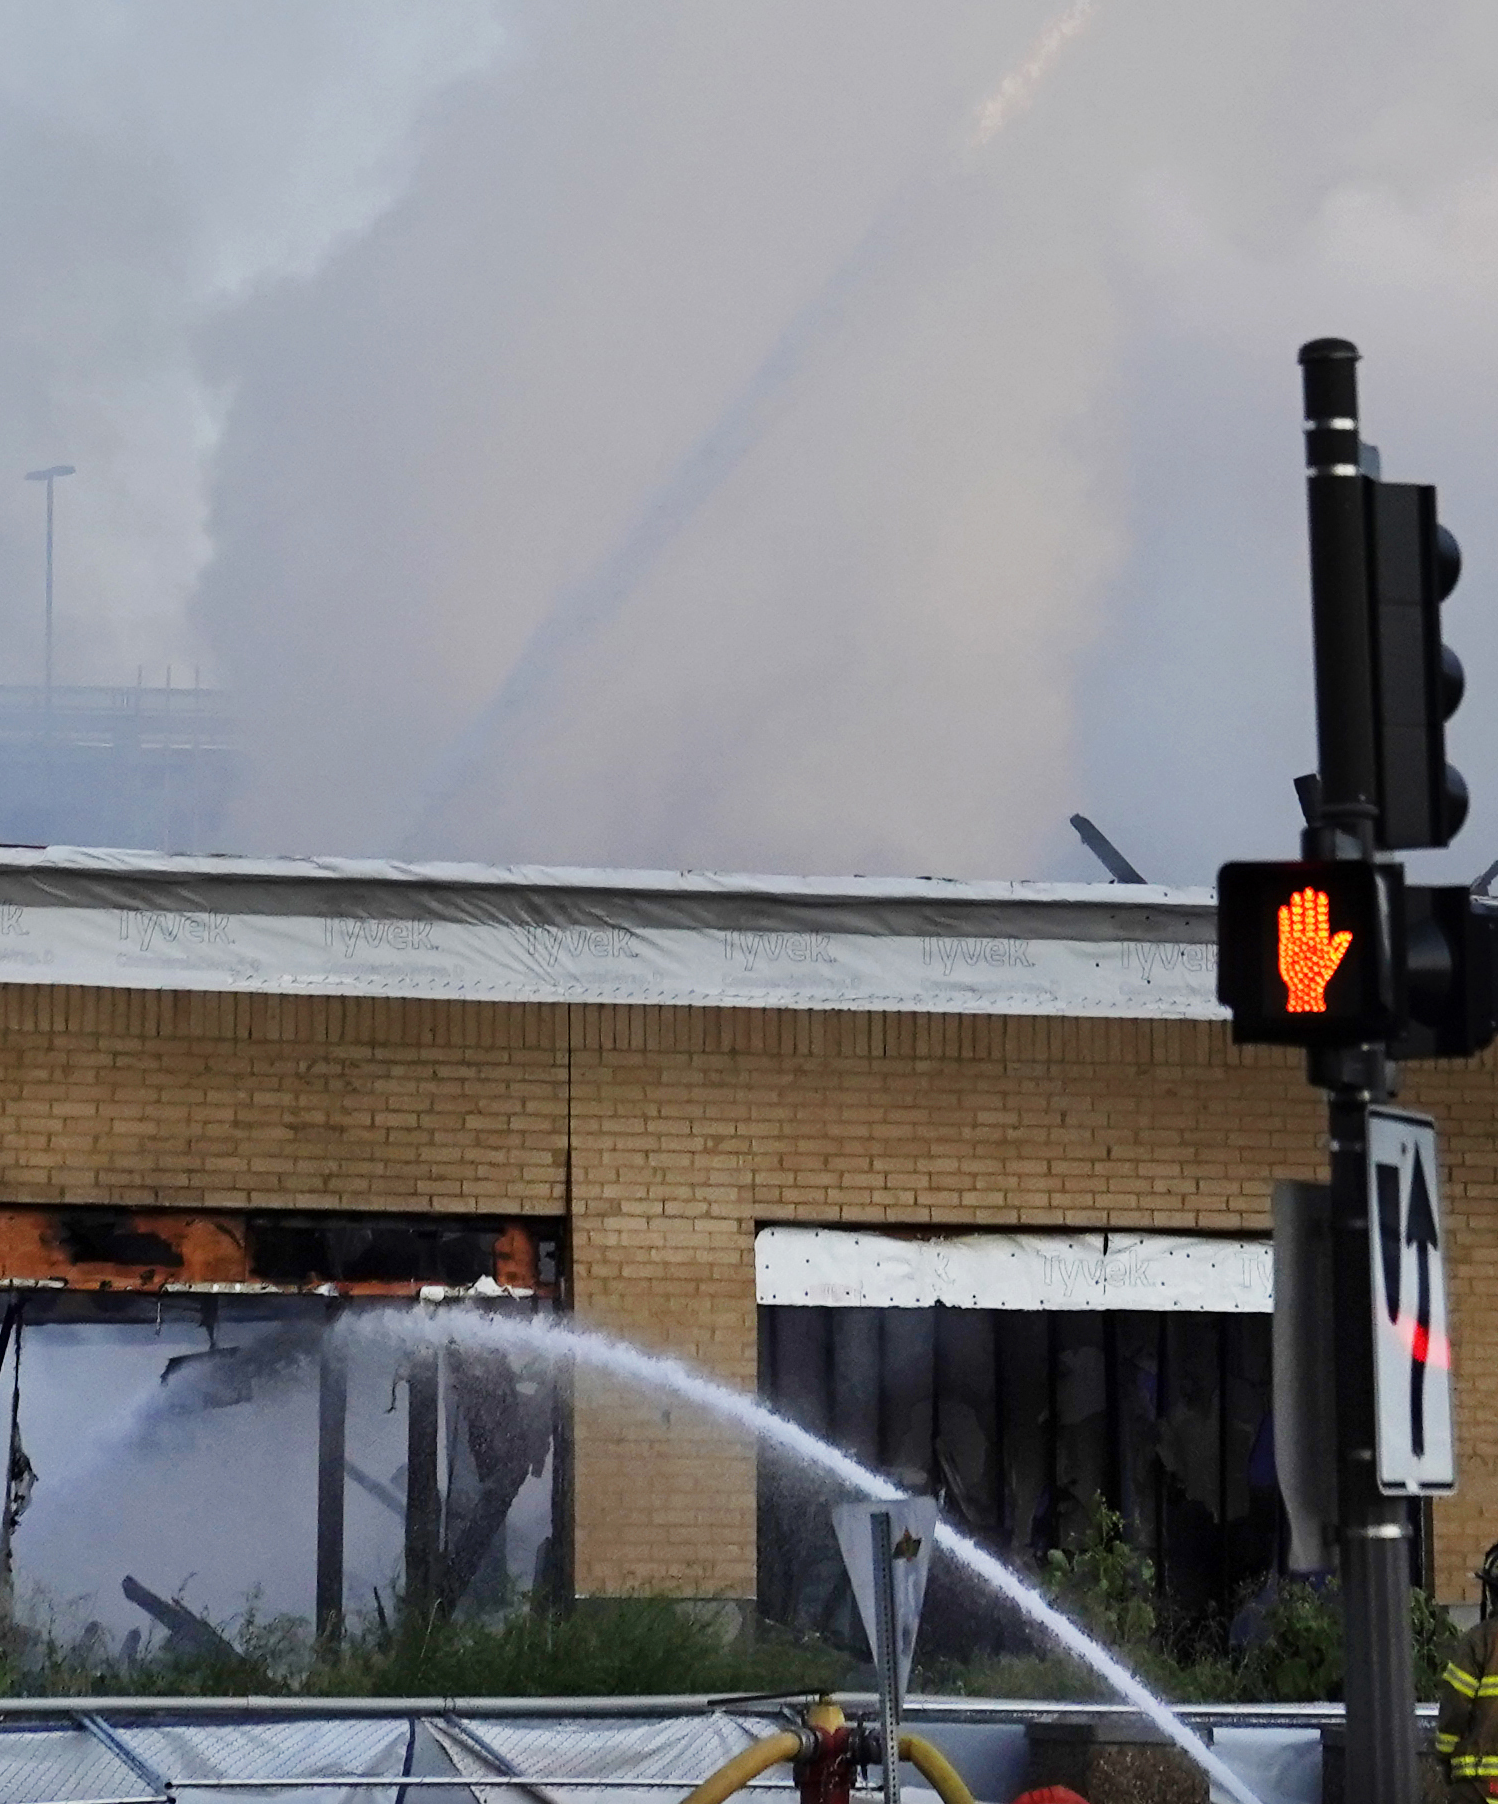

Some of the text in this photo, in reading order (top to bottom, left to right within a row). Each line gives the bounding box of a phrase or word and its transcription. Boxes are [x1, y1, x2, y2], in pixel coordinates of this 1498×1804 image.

[119, 909, 233, 952] Tyvek
[324, 917, 438, 959] Tyvek
[723, 930, 836, 972] Tyvek
[922, 936, 1035, 977] Tyvek
[1037, 1249, 1151, 1298] Tyvek
